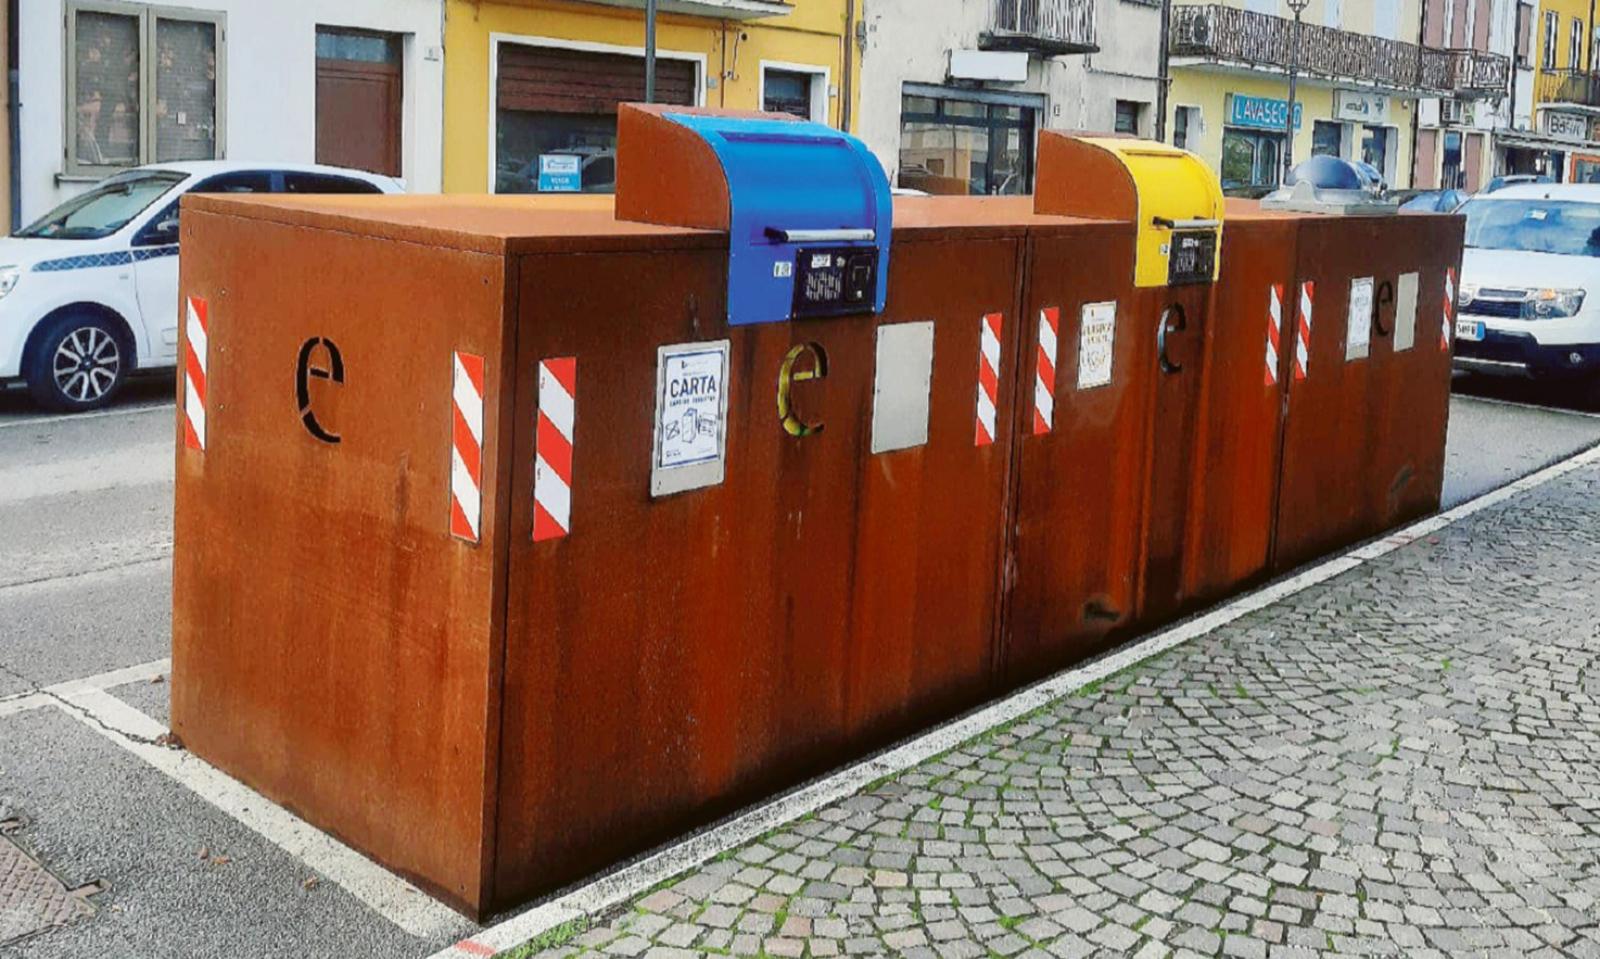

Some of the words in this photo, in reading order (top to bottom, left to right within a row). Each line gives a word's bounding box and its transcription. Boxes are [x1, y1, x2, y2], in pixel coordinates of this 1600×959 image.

[1235, 98, 1302, 125] LAVASECO
[297, 336, 344, 443] e
[670, 374, 717, 398] CARTA
[777, 341, 829, 436] e
